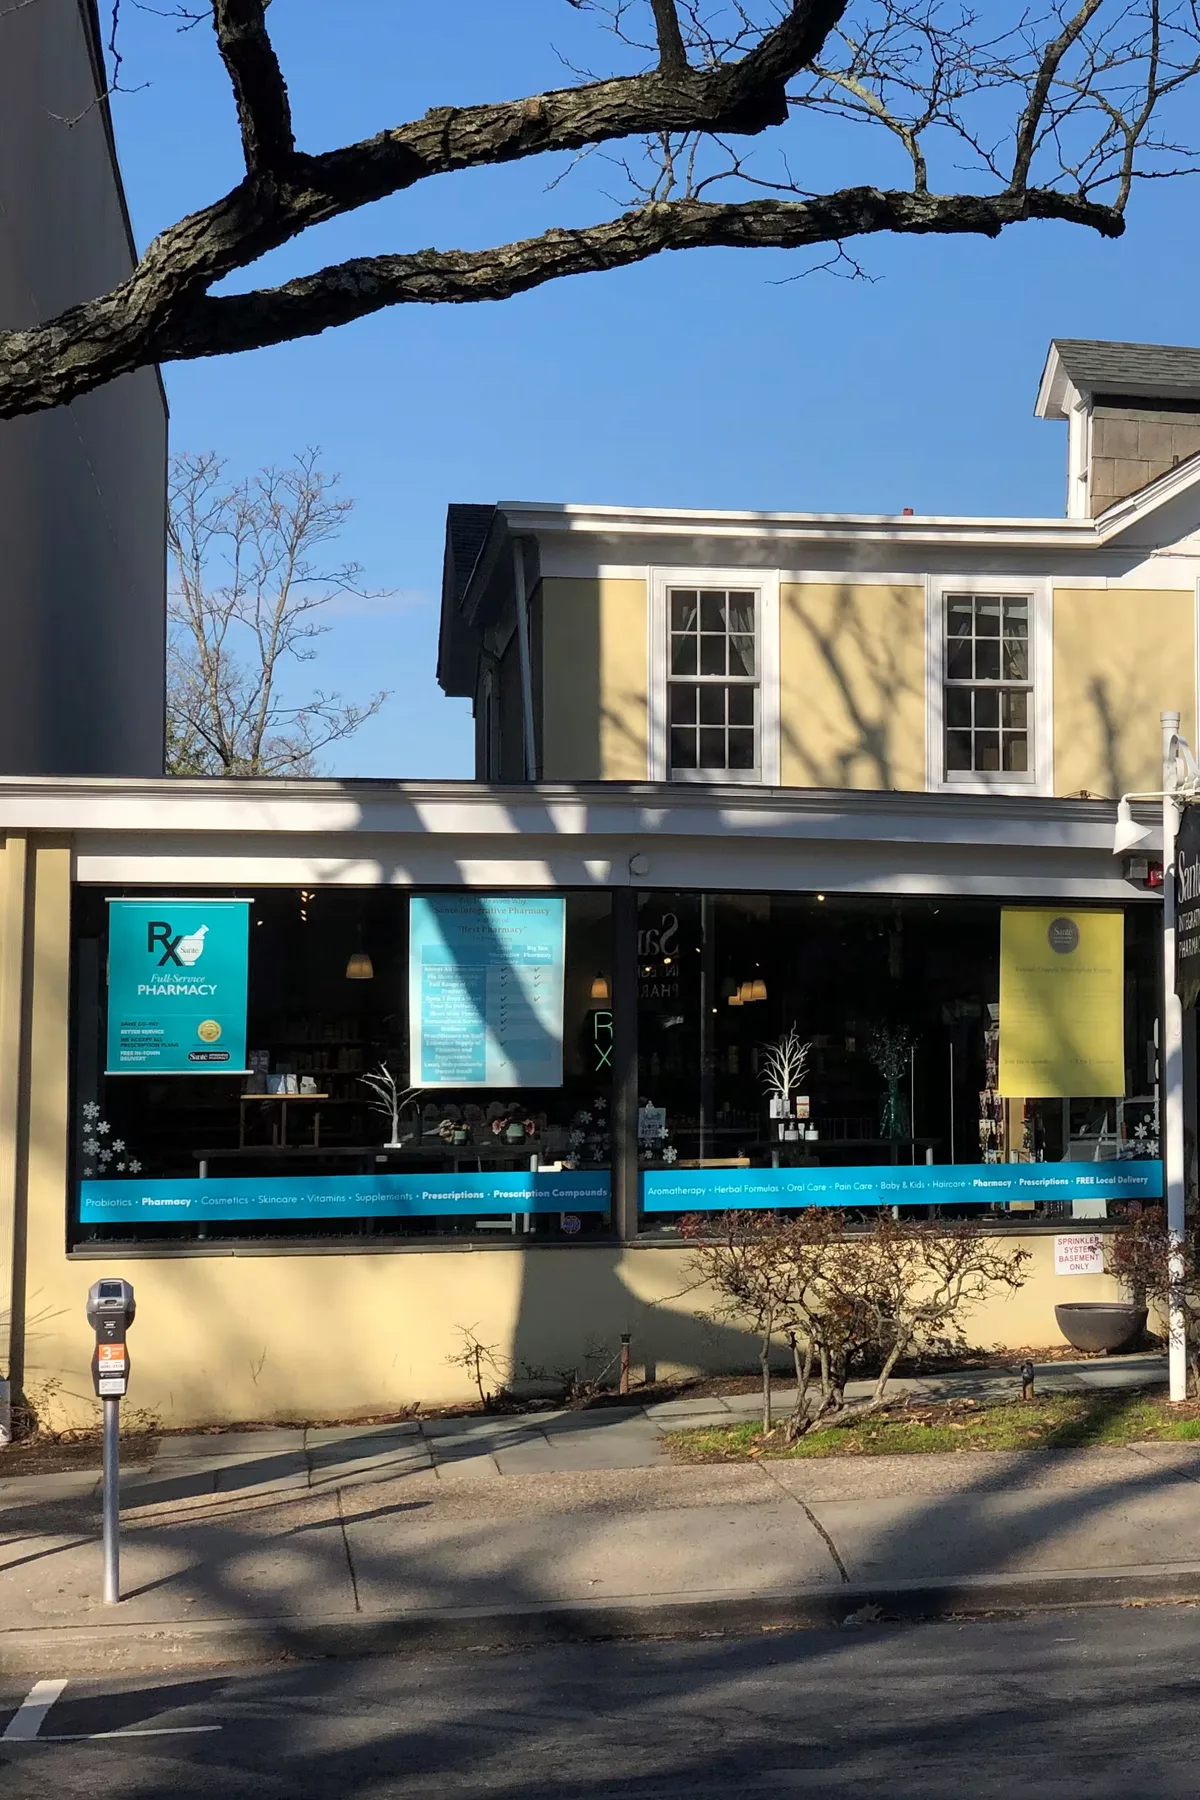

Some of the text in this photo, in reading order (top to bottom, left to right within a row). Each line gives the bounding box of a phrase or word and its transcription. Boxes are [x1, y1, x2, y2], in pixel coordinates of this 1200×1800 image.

[508, 906, 550, 916] Pharmacy
[150, 974, 206, 983] Full-Service
[137, 984, 218, 996] PHARMACY
[648, 1187, 706, 1196] Aromatherapy
[714, 1184, 742, 1193] Herbal
[744, 1184, 779, 1193] Formulas
[787, 1183, 804, 1192] Oral
[807, 1183, 827, 1192] Care
[835, 1182, 852, 1191] Pain
[853, 1182, 873, 1190] Care
[880, 1181, 901, 1191] Baby
[909, 1180, 925, 1189] Kids
[932, 1180, 966, 1189] Haircare
[973, 1178, 1012, 1188] Pharmacy
[1019, 1177, 1069, 1187] Prescriptions
[1096, 1176, 1117, 1184] Local
[1118, 1176, 1149, 1186] Delivery
[85, 1188, 608, 1208] Probiotics Pharmacy Cosmetics Skincare Vitamins Supplements Prescriptions Prescription Compounds
[1057, 1237, 1100, 1246] SPRINKLER
[1058, 1254, 1100, 1262] BASEMENT
[1069, 1263, 1089, 1271] ONLY
[102, 1347, 112, 1360] 3
